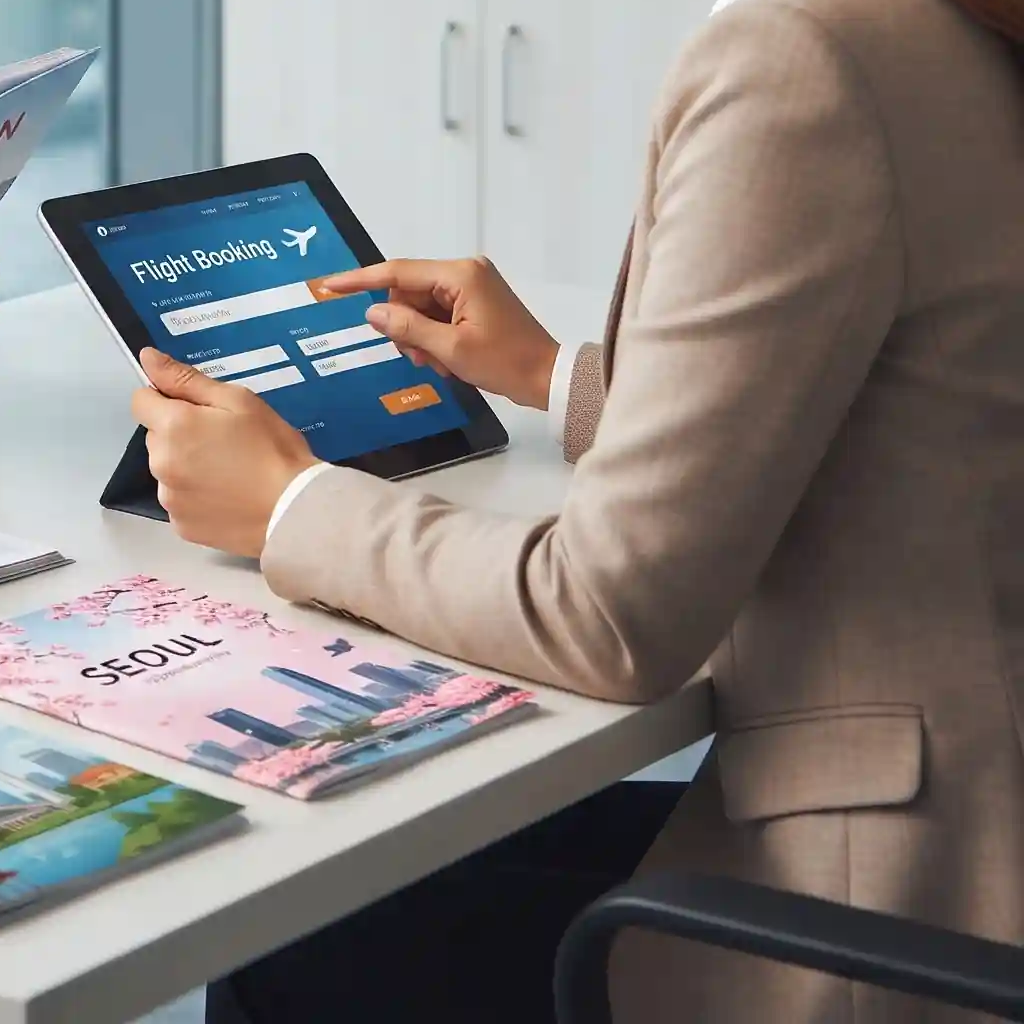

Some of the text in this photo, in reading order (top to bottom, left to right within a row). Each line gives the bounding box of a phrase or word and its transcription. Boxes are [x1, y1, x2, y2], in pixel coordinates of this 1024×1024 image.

[130, 238, 278, 283] Flight Booking
[80, 634, 224, 686] SEOUL
